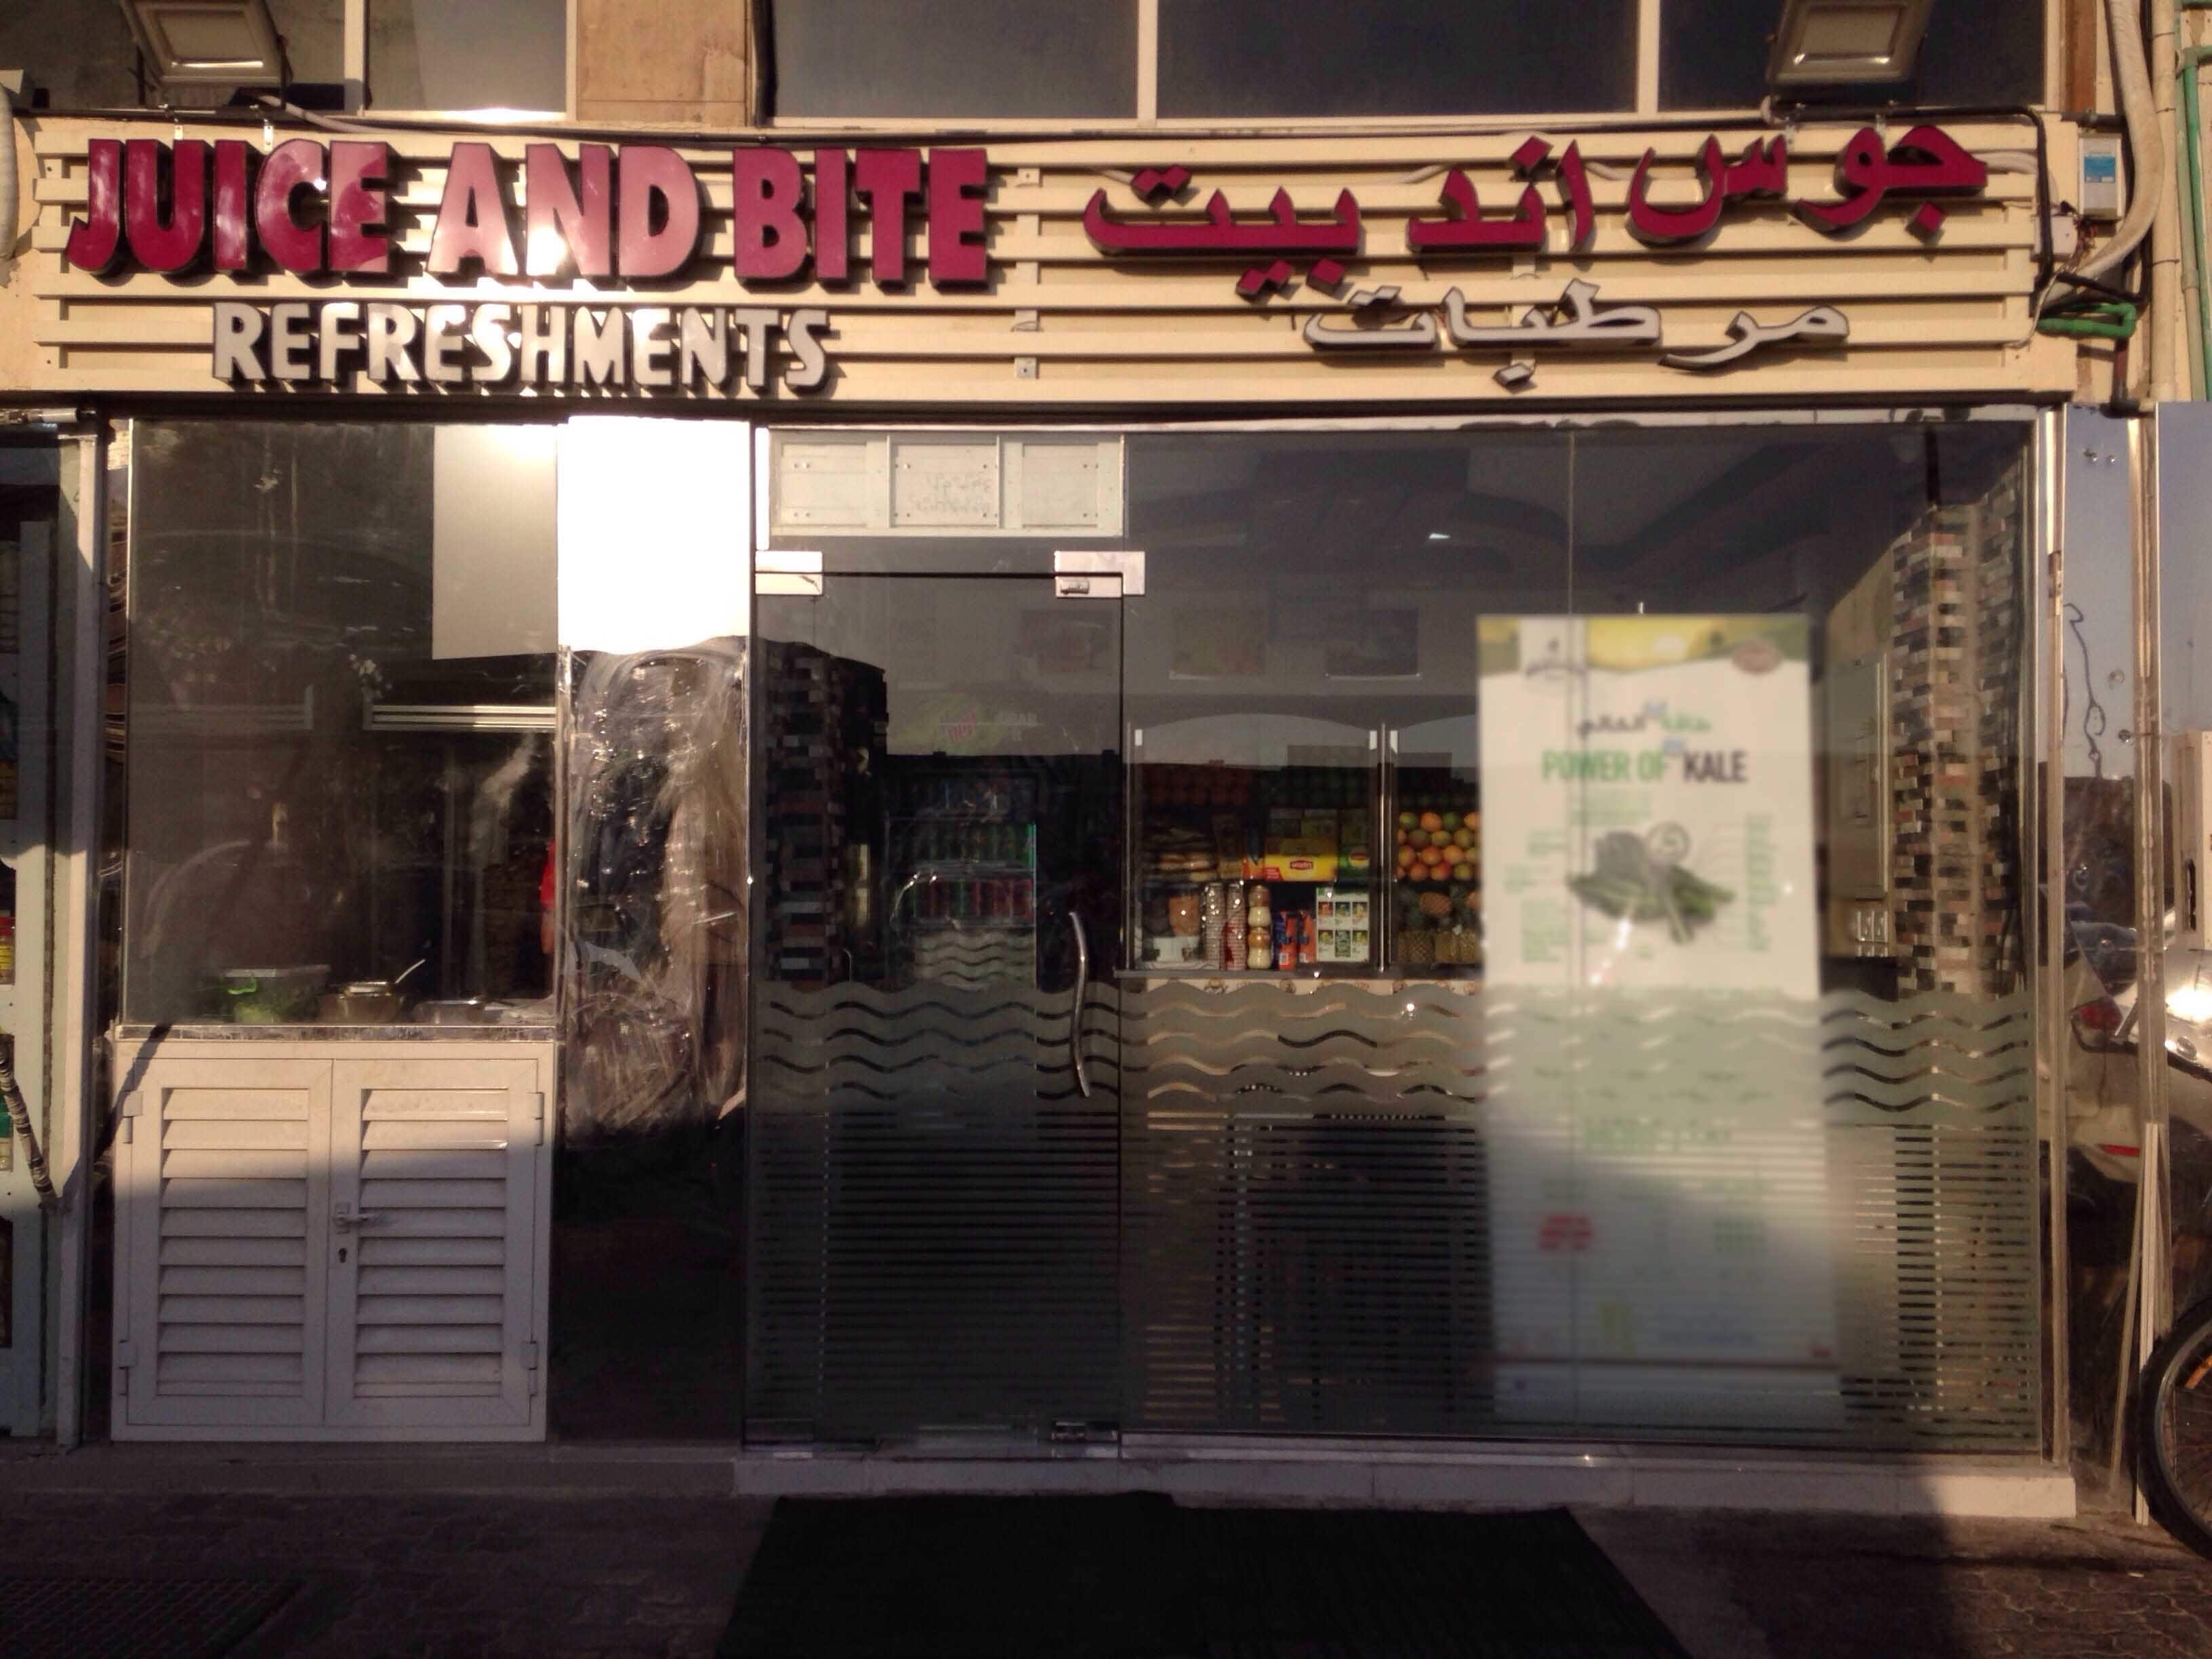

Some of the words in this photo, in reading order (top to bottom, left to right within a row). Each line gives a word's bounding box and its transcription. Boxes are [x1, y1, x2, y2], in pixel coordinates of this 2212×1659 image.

[64, 138, 390, 274] JUICE
[426, 142, 699, 278] AND
[733, 147, 987, 285] BITE
[1084, 165, 1364, 298] بيت
[1627, 125, 1987, 247] جوس
[213, 302, 829, 390] REFRESHMENTS
[1304, 278, 1850, 389] مرطبات
[1542, 749, 1631, 782] POWER
[1636, 749, 1668, 781] OF
[1683, 750, 1748, 783] KALE
